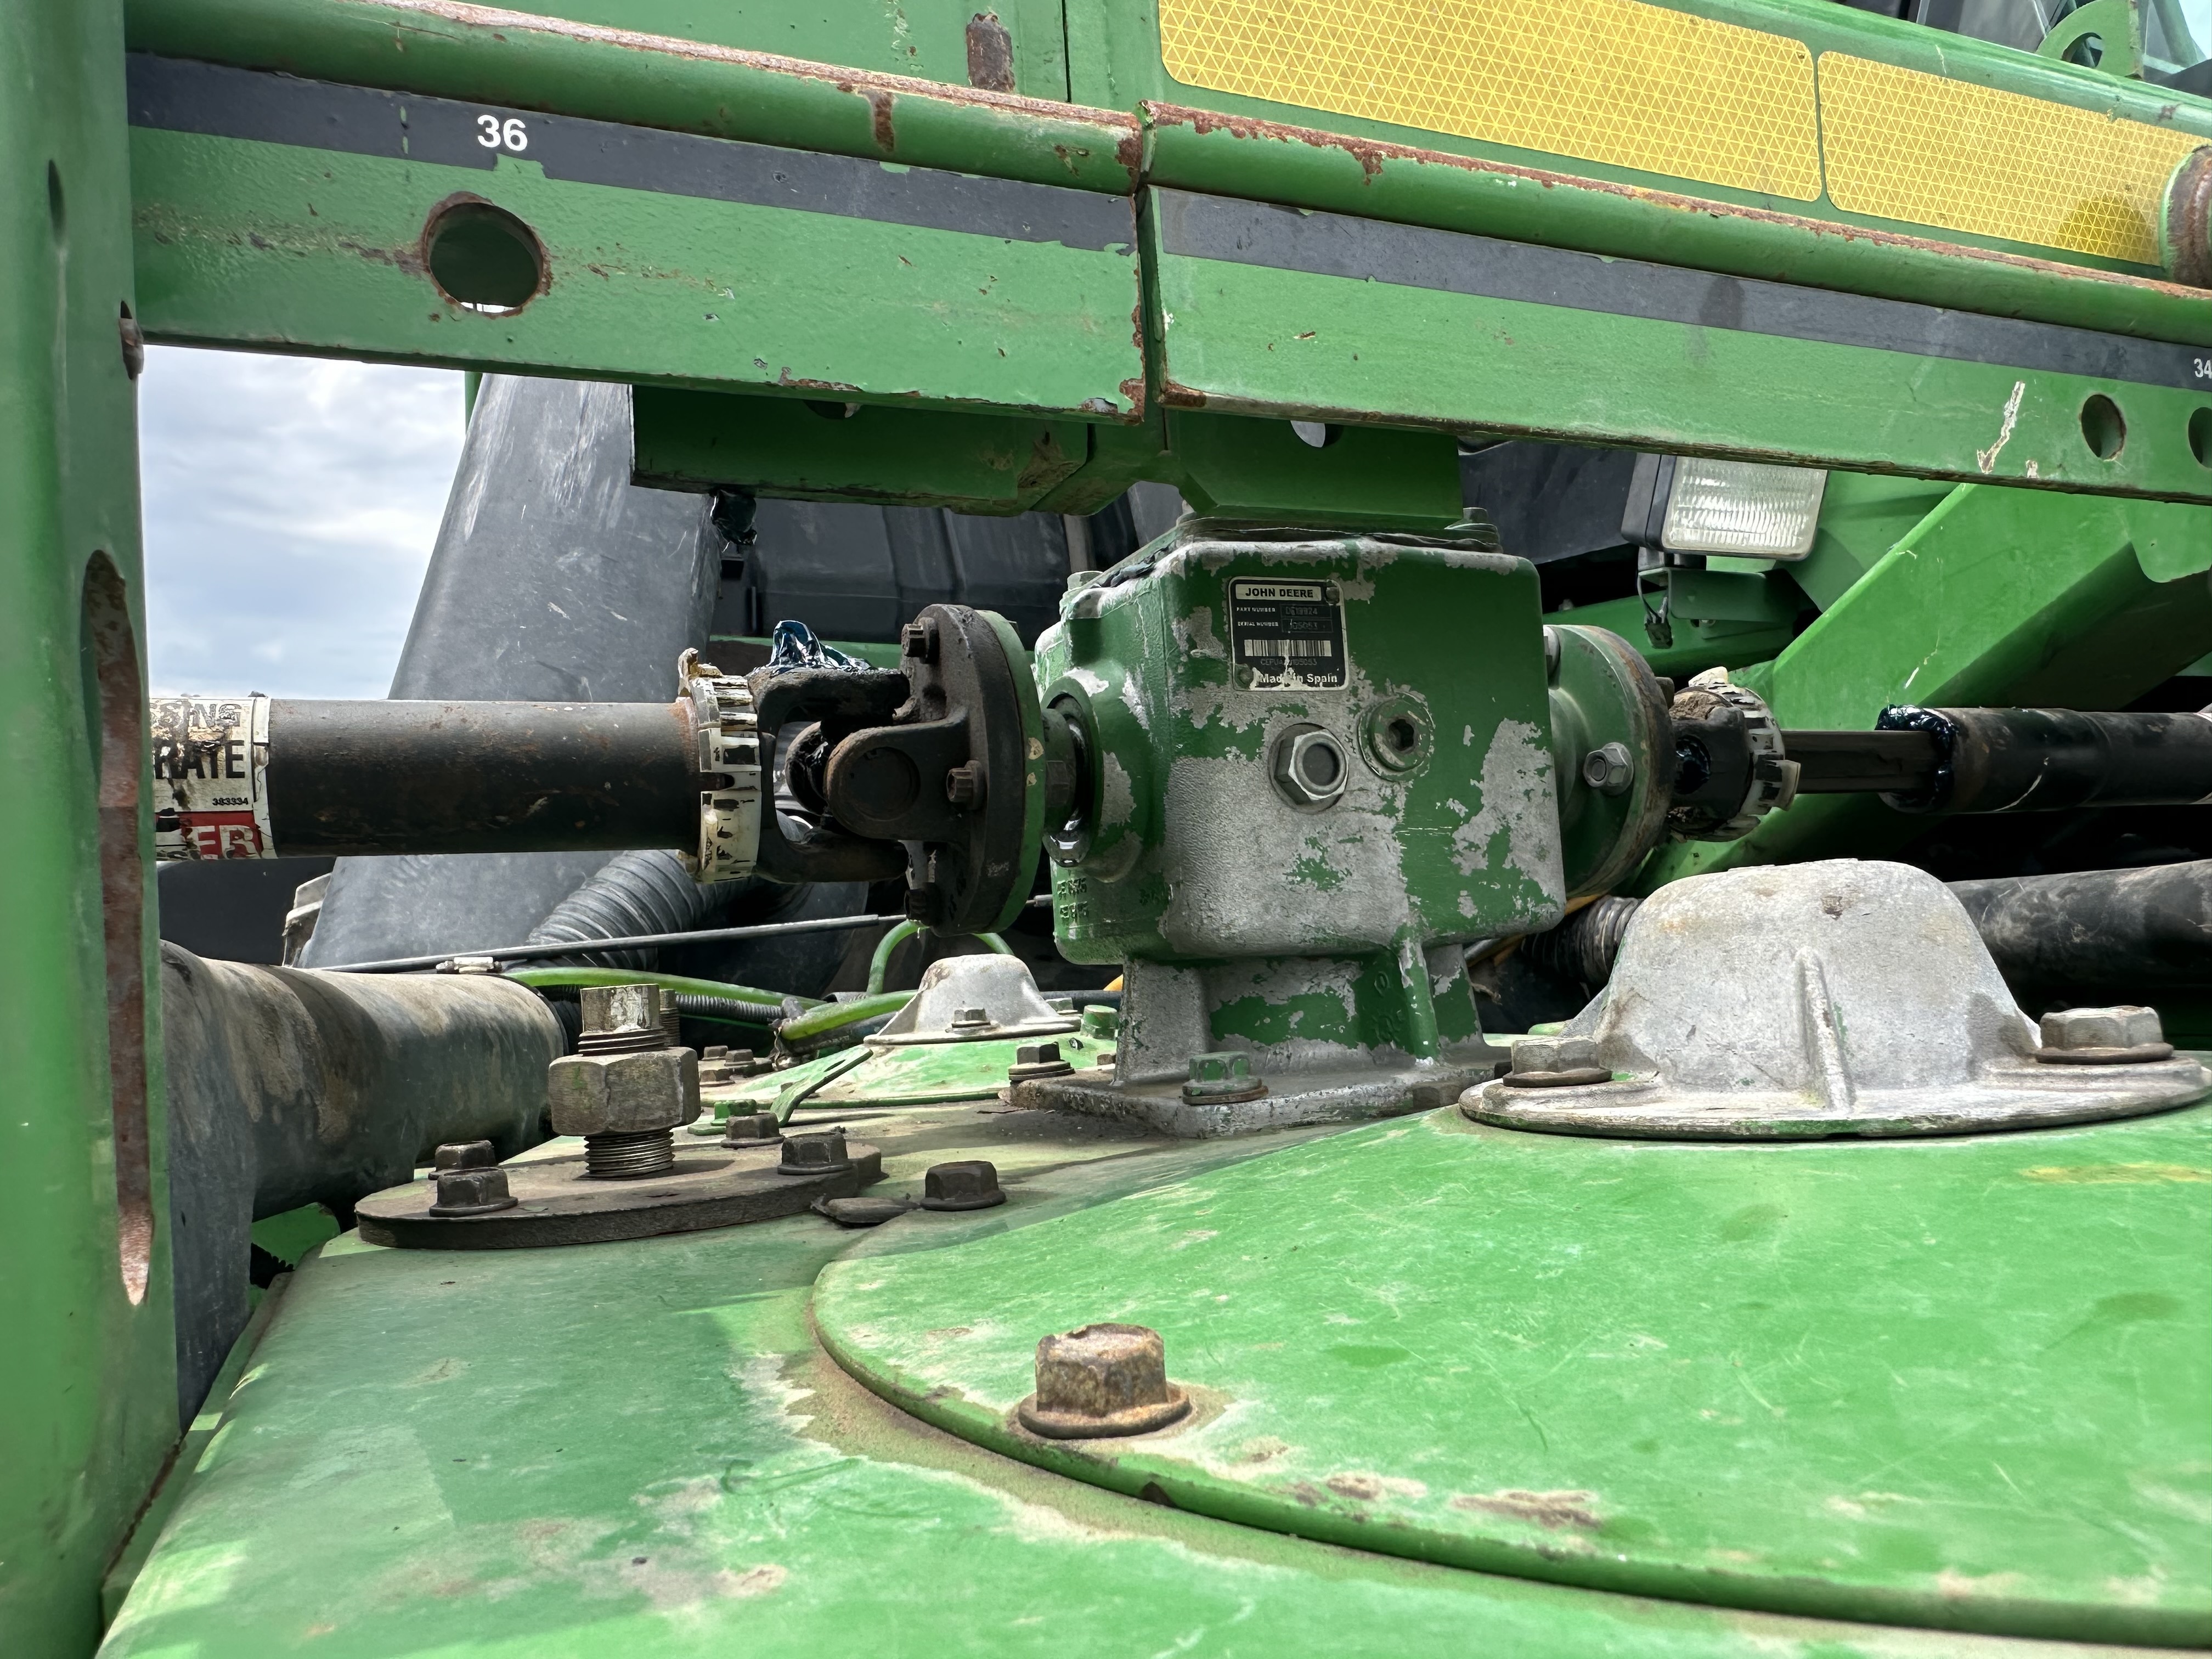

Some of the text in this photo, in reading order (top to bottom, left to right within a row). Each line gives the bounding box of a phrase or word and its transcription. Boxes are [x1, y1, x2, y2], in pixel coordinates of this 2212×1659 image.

[477, 114, 528, 151] 36
[1245, 588, 1313, 598] JOHN DEERE
[1260, 673, 1288, 683] Mad
[1307, 673, 1338, 685] Spain
